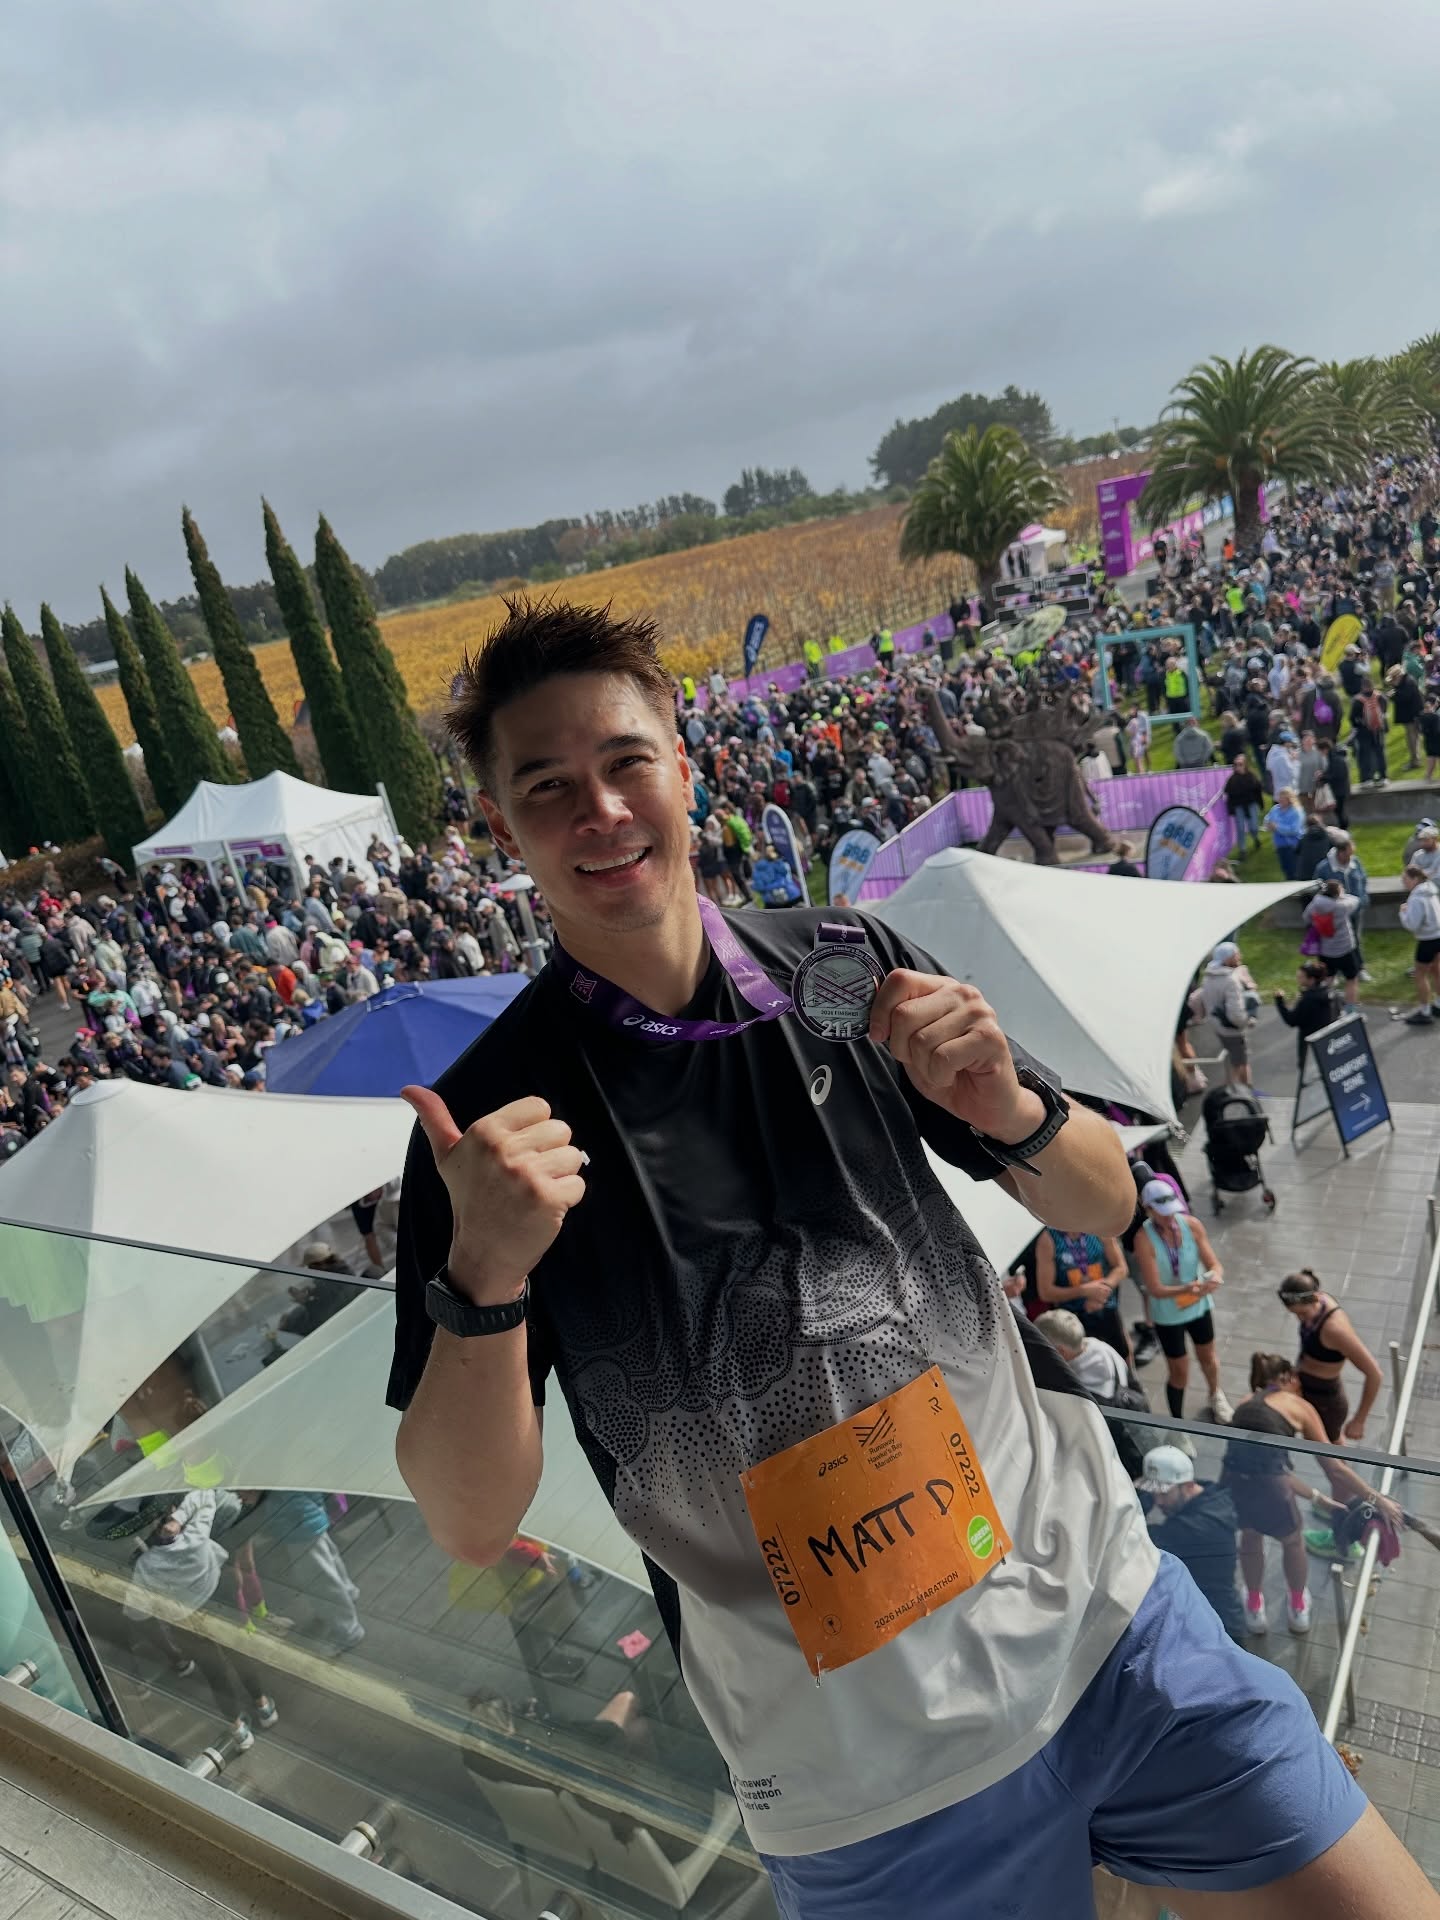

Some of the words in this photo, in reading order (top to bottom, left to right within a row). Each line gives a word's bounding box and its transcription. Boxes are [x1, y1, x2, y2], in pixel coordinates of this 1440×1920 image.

[640, 1019, 683, 1036] asics
[867, 1447, 892, 1465] Hawke's
[891, 1442, 903, 1452] Bay
[868, 1436, 896, 1455] Runaway
[827, 1454, 849, 1471] asics
[874, 1451, 902, 1471] Marathon
[949, 1432, 981, 1498] 07222
[807, 1491, 916, 1577] MATT
[925, 1478, 955, 1515] D
[761, 1535, 801, 1606] 07222
[874, 1611, 895, 1629] 2026
[894, 1599, 917, 1617] HALF
[916, 1570, 959, 1604] MARATHON
